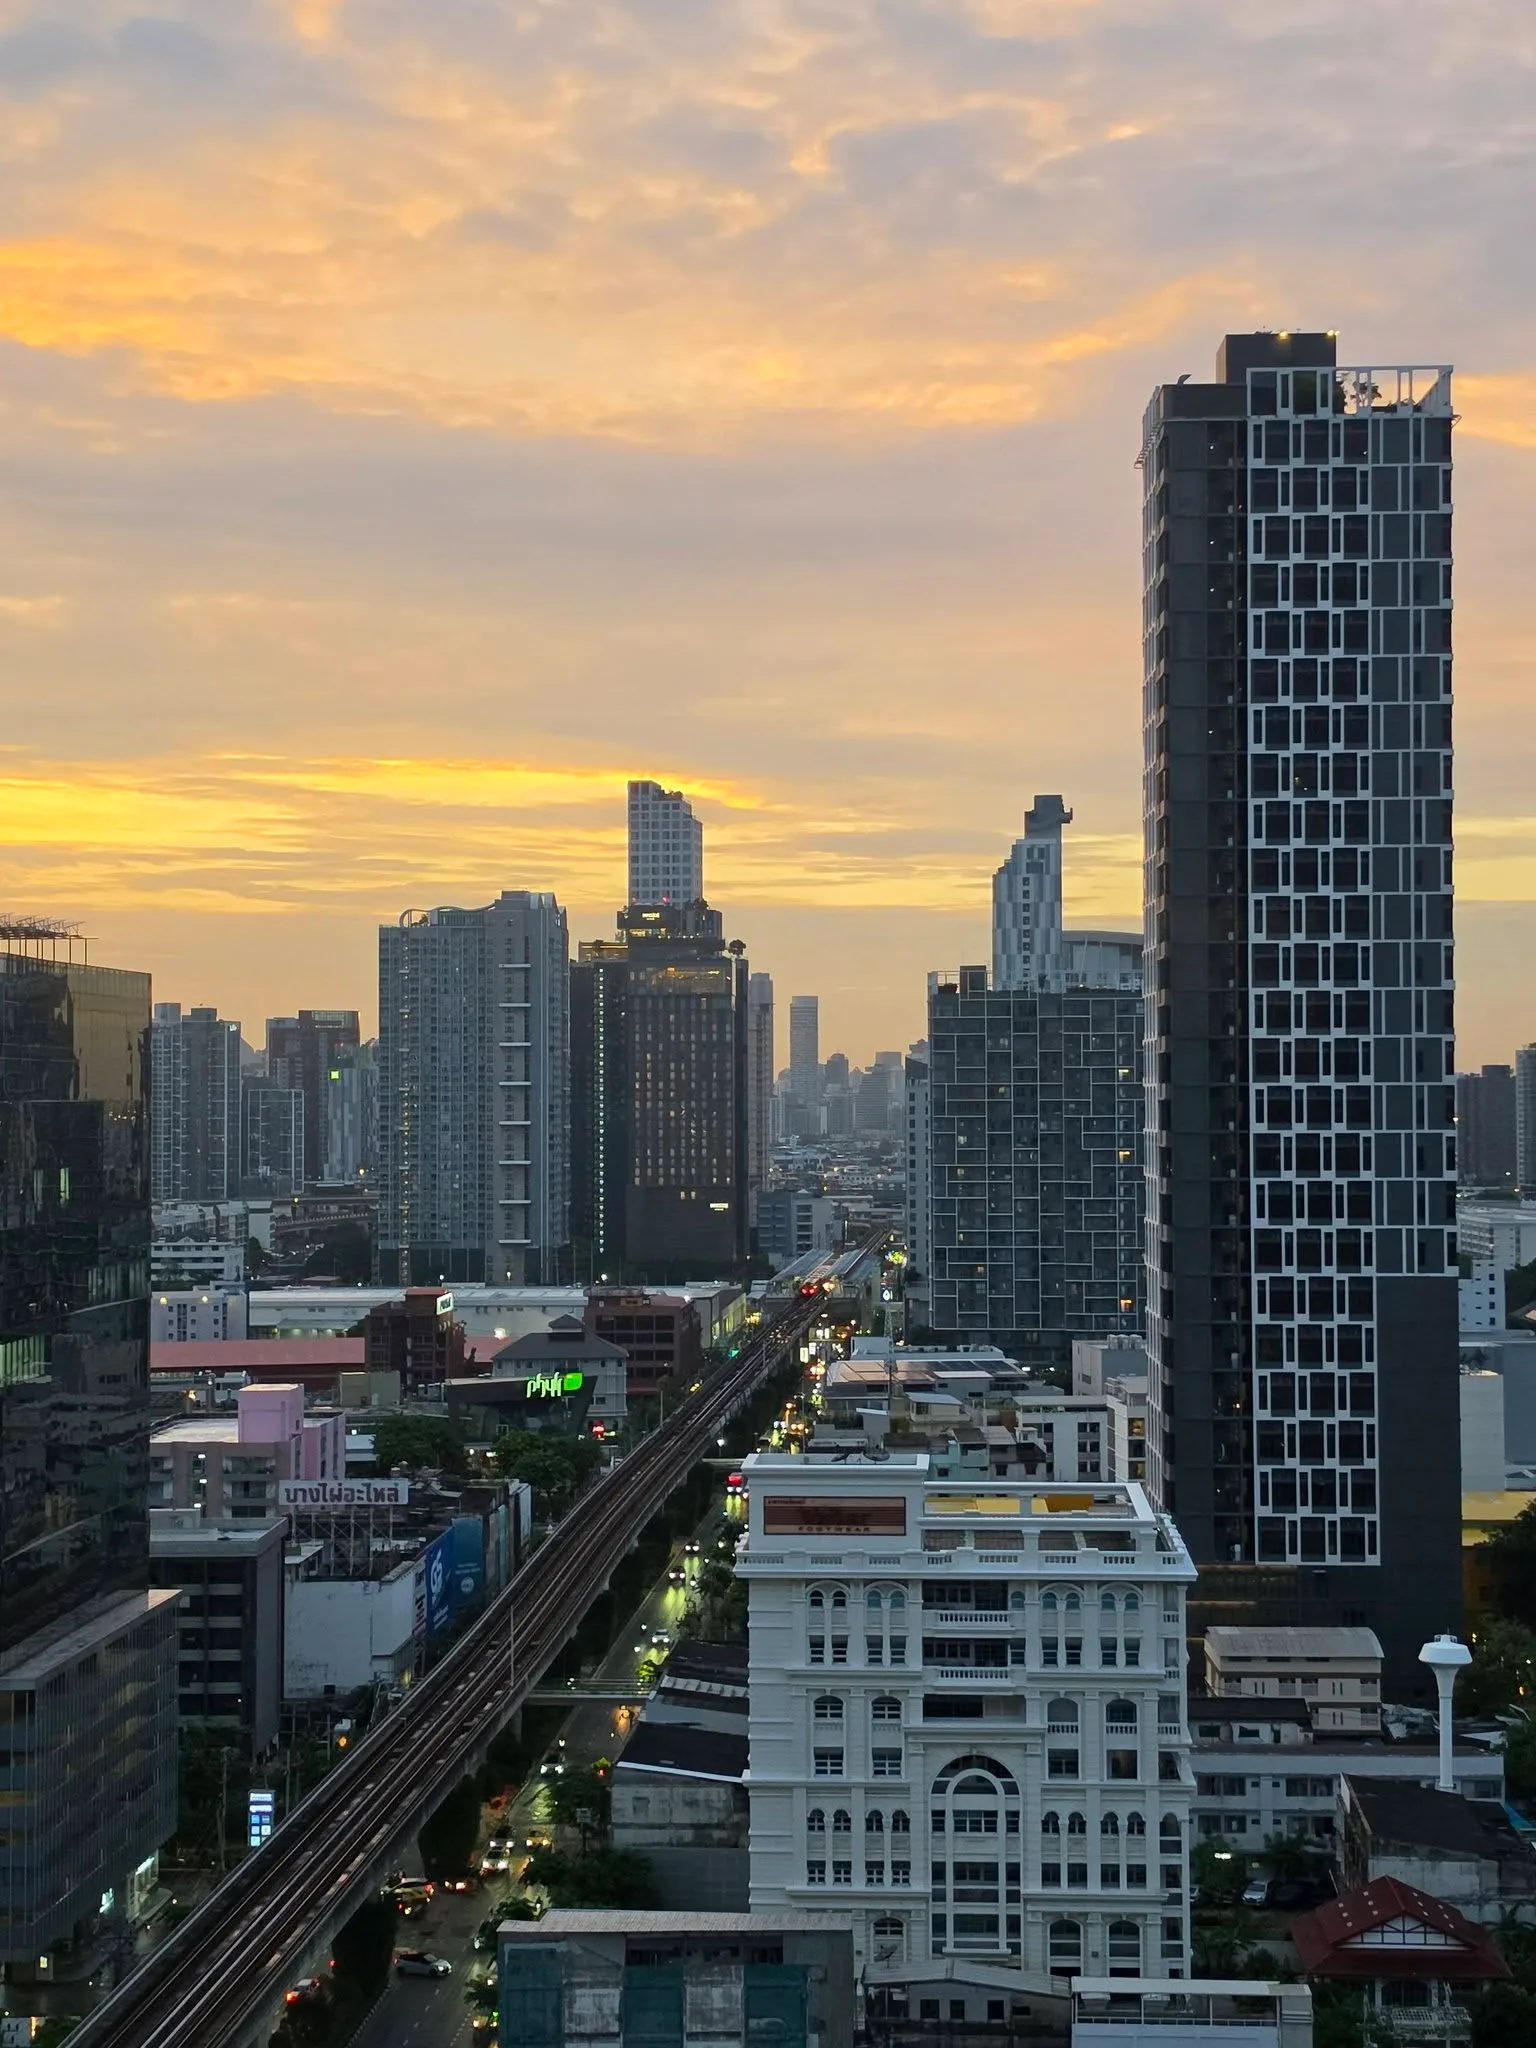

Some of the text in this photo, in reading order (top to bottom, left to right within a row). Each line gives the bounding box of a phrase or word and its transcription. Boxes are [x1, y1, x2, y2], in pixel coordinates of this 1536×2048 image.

[284, 1482, 399, 1503] บางไผ่อะไหล่
